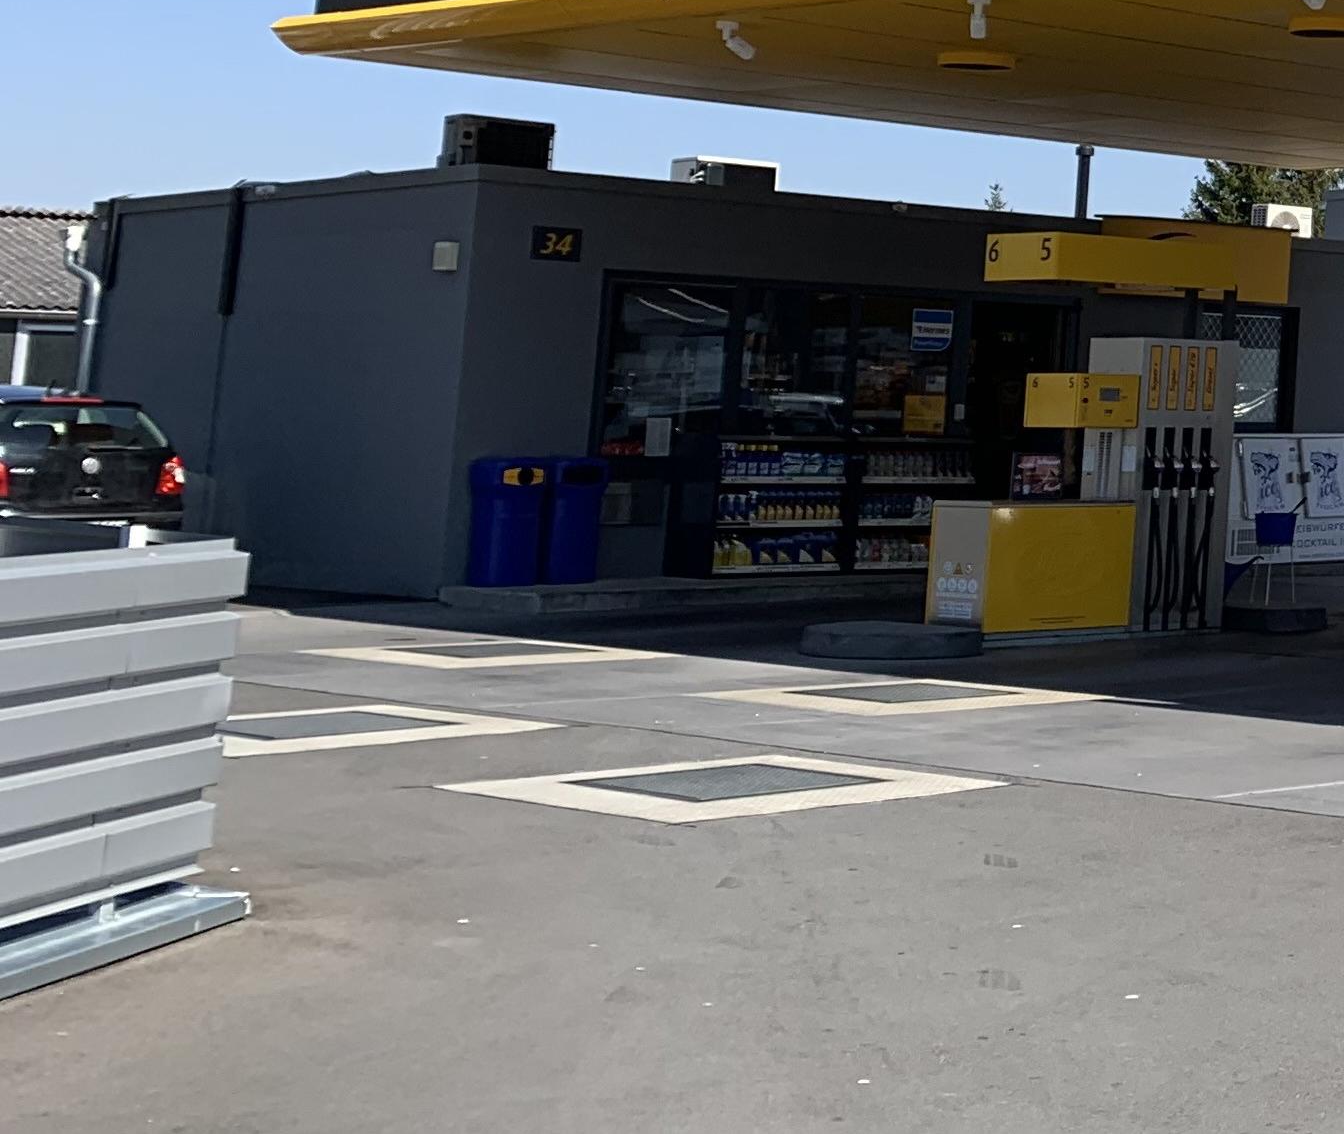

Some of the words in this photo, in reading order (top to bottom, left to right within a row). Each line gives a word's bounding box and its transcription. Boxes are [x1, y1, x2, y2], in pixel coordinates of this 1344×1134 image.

[540, 232, 573, 256] 34
[1040, 238, 1052, 261] 5
[988, 240, 999, 262] 6
[1032, 377, 1039, 388] 6
[1069, 377, 1075, 388] 5
[1083, 377, 1090, 389] 5
[1296, 538, 1337, 548] OCKTAIL
